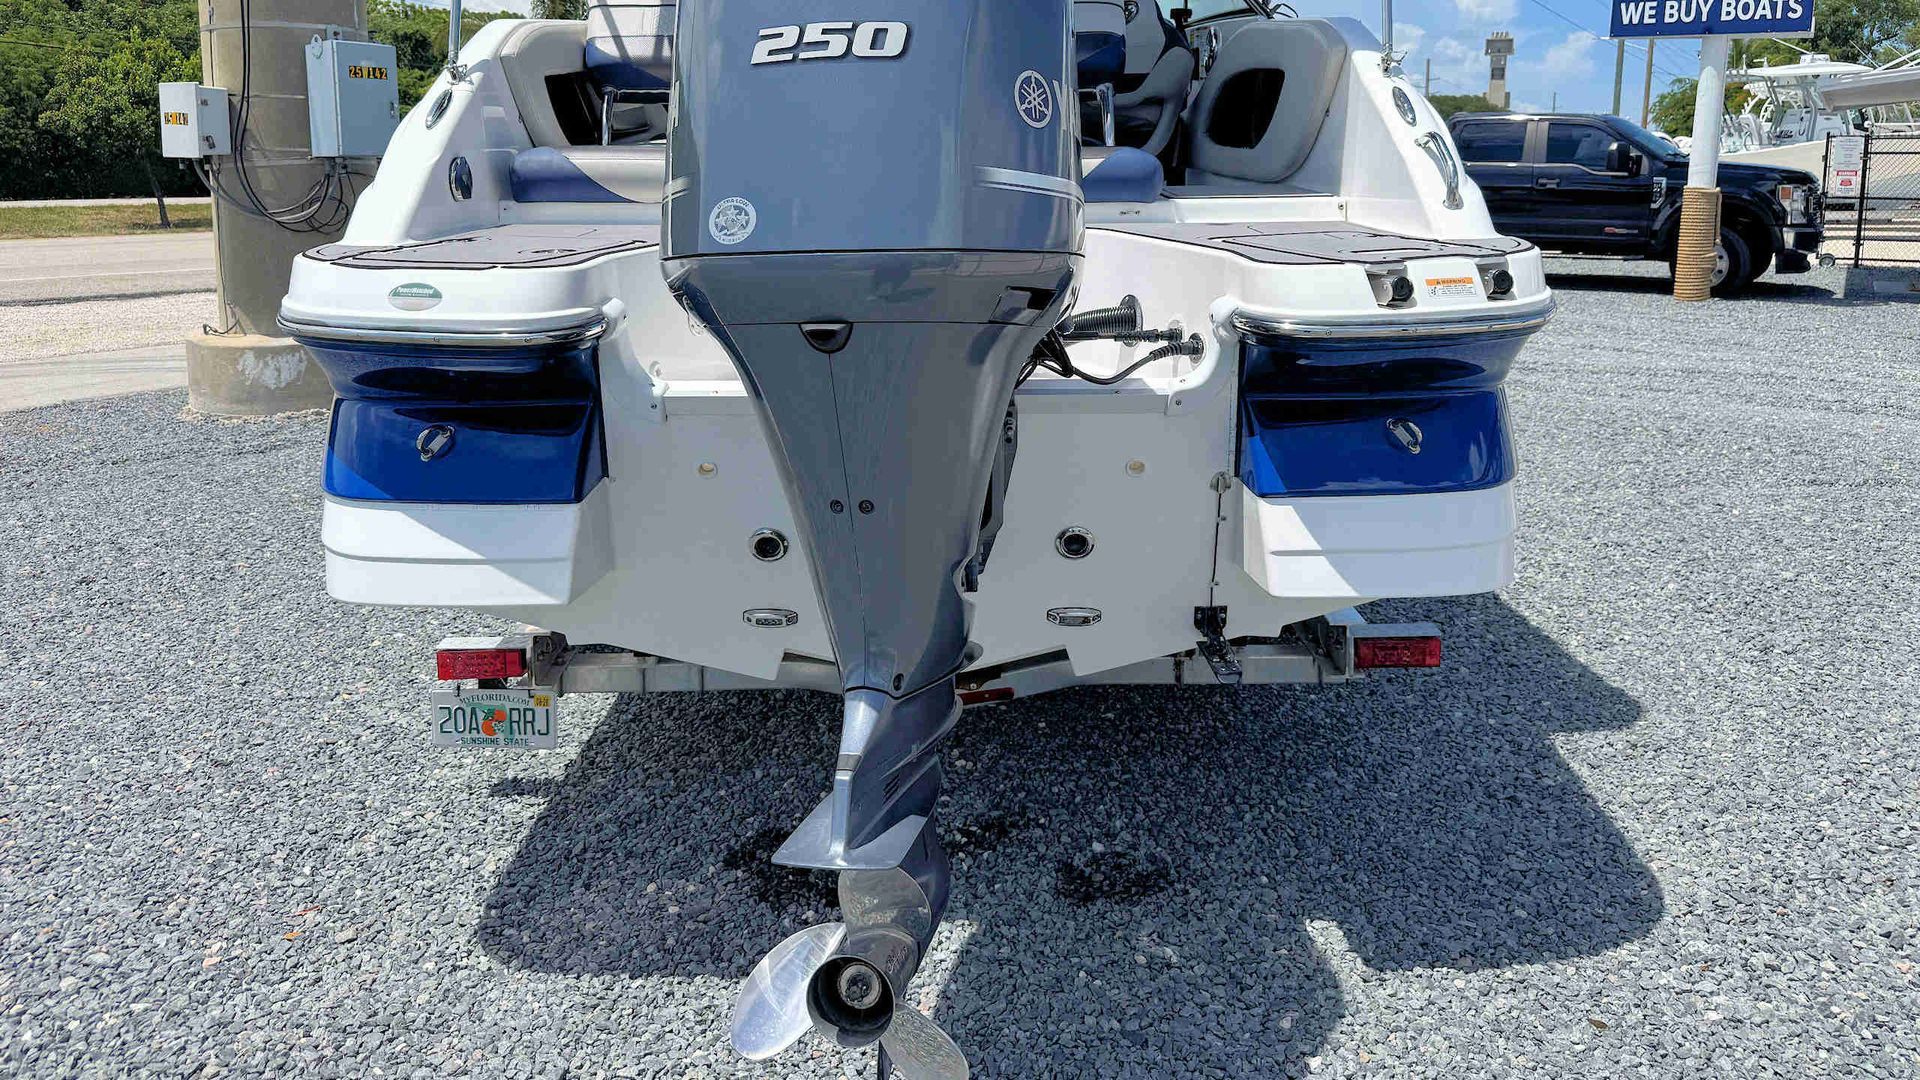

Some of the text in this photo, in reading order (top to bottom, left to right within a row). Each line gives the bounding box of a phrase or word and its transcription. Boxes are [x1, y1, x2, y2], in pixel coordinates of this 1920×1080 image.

[1620, 0, 1803, 25] WE BUY BOATS
[751, 21, 908, 65] 250
[349, 66, 387, 80] 25W142
[509, 707, 550, 736] RRJ
[461, 737, 529, 747] SUNSHINE STATE
